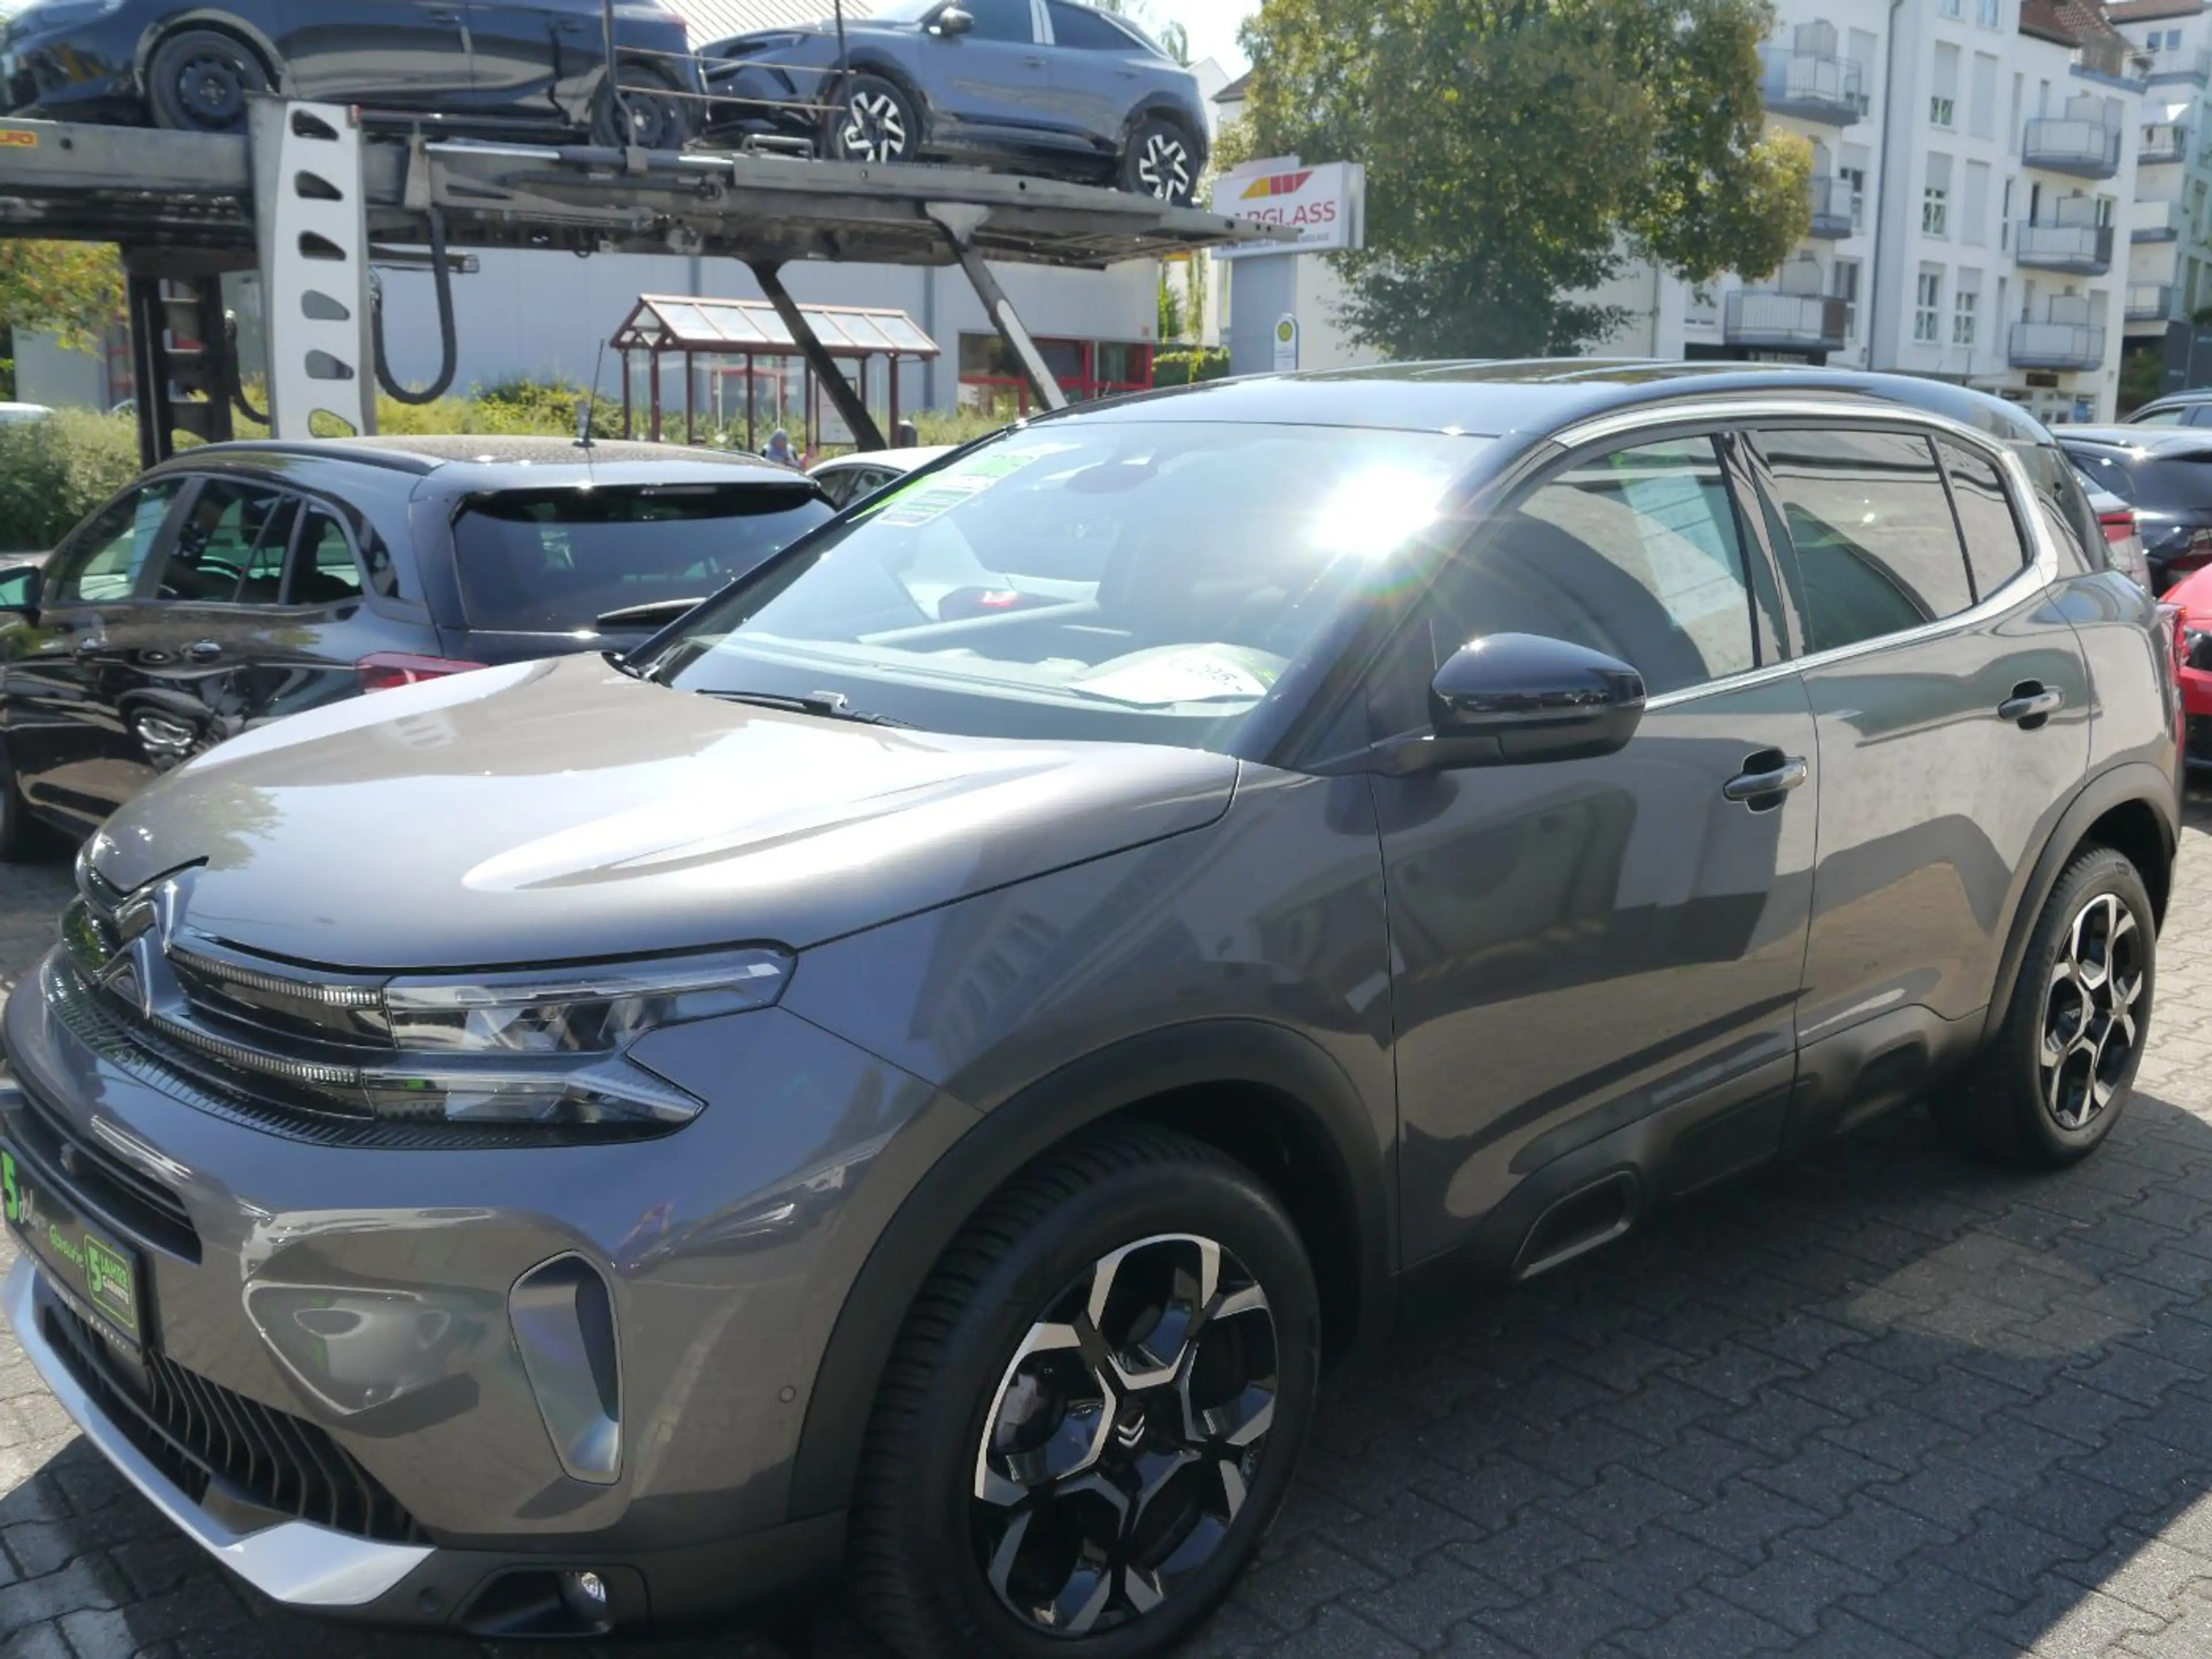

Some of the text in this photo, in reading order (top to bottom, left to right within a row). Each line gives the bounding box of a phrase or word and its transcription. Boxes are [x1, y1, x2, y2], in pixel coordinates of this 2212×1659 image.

[1234, 200, 1336, 225] RGLASS
[2, 1151, 18, 1219] 5
[88, 1246, 102, 1292] 5
